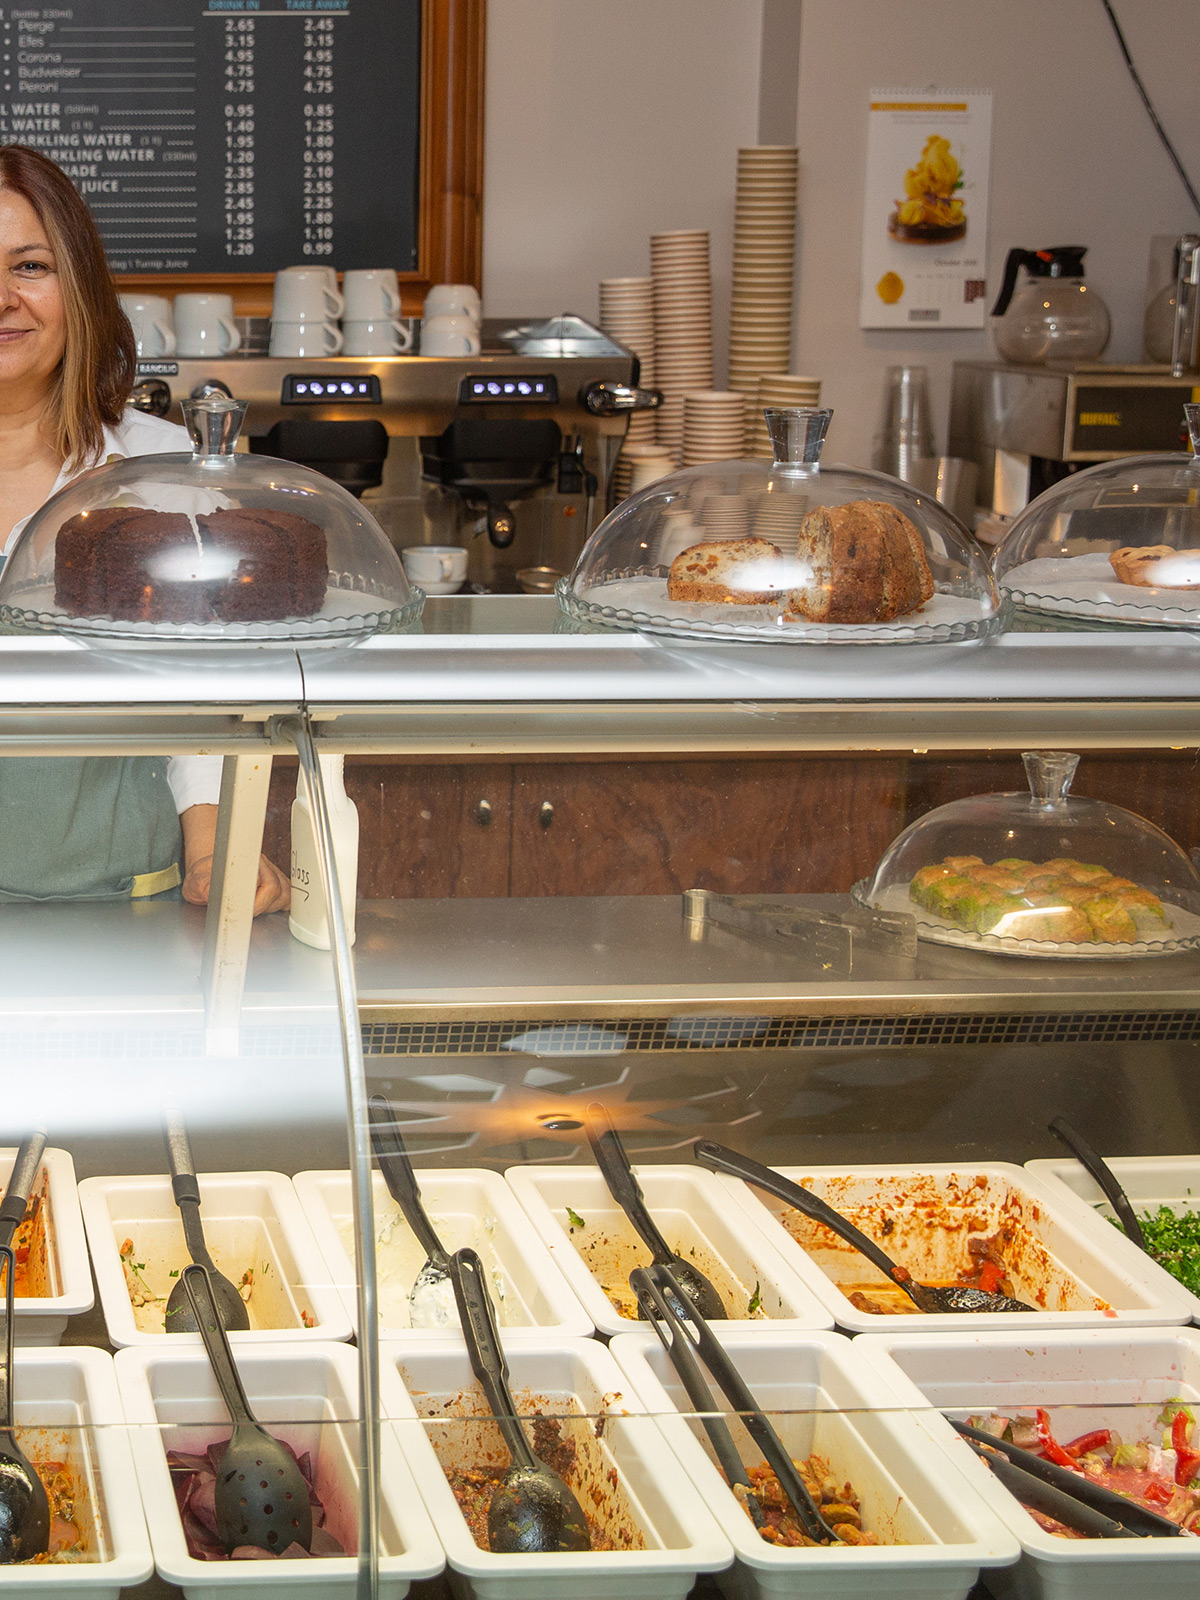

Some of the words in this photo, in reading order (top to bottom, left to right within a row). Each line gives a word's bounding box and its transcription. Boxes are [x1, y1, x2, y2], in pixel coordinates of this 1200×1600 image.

[208, 0, 244, 10] DRINK
[225, 19, 255, 31] 2.65
[304, 19, 334, 31] 2.45
[18, 35, 45, 48] Efes
[225, 34, 255, 47] 3.15
[304, 34, 334, 46] 3.15
[17, 51, 62, 63] Corona
[224, 50, 254, 62] 4.95
[303, 50, 333, 62] 4.95
[18, 66, 81, 78] Budweiser
[225, 65, 254, 78] 4.75
[303, 65, 333, 78] 4.75
[18, 81, 59, 93] Peroni
[225, 80, 255, 93] 4.75
[303, 80, 333, 93] 4.75
[11, 103, 60, 116] WATER
[225, 104, 255, 117] 0.95
[304, 104, 334, 117] 0.85
[11, 118, 60, 132] WATER
[225, 119, 255, 132] 1.40
[305, 119, 334, 132] 1.25
[83, 133, 132, 146] WATER
[225, 135, 255, 148] 1.95
[304, 135, 334, 147] 1.80
[106, 148, 155, 161] WATER
[225, 150, 255, 163] 1.20
[304, 150, 334, 163] 0.99
[224, 166, 254, 179] 2.35
[303, 166, 333, 178] 2.10
[82, 180, 119, 194] JUICE
[224, 181, 254, 194] 2.85
[303, 181, 333, 194] 2.55
[224, 197, 254, 210] 2.45
[303, 196, 334, 209] 2.25
[224, 212, 254, 225] 1.95
[303, 211, 334, 224] 1.80
[224, 227, 254, 240] 1.25
[303, 226, 334, 239] 1.10
[224, 243, 254, 256] 1.20
[303, 242, 334, 255] 0.99
